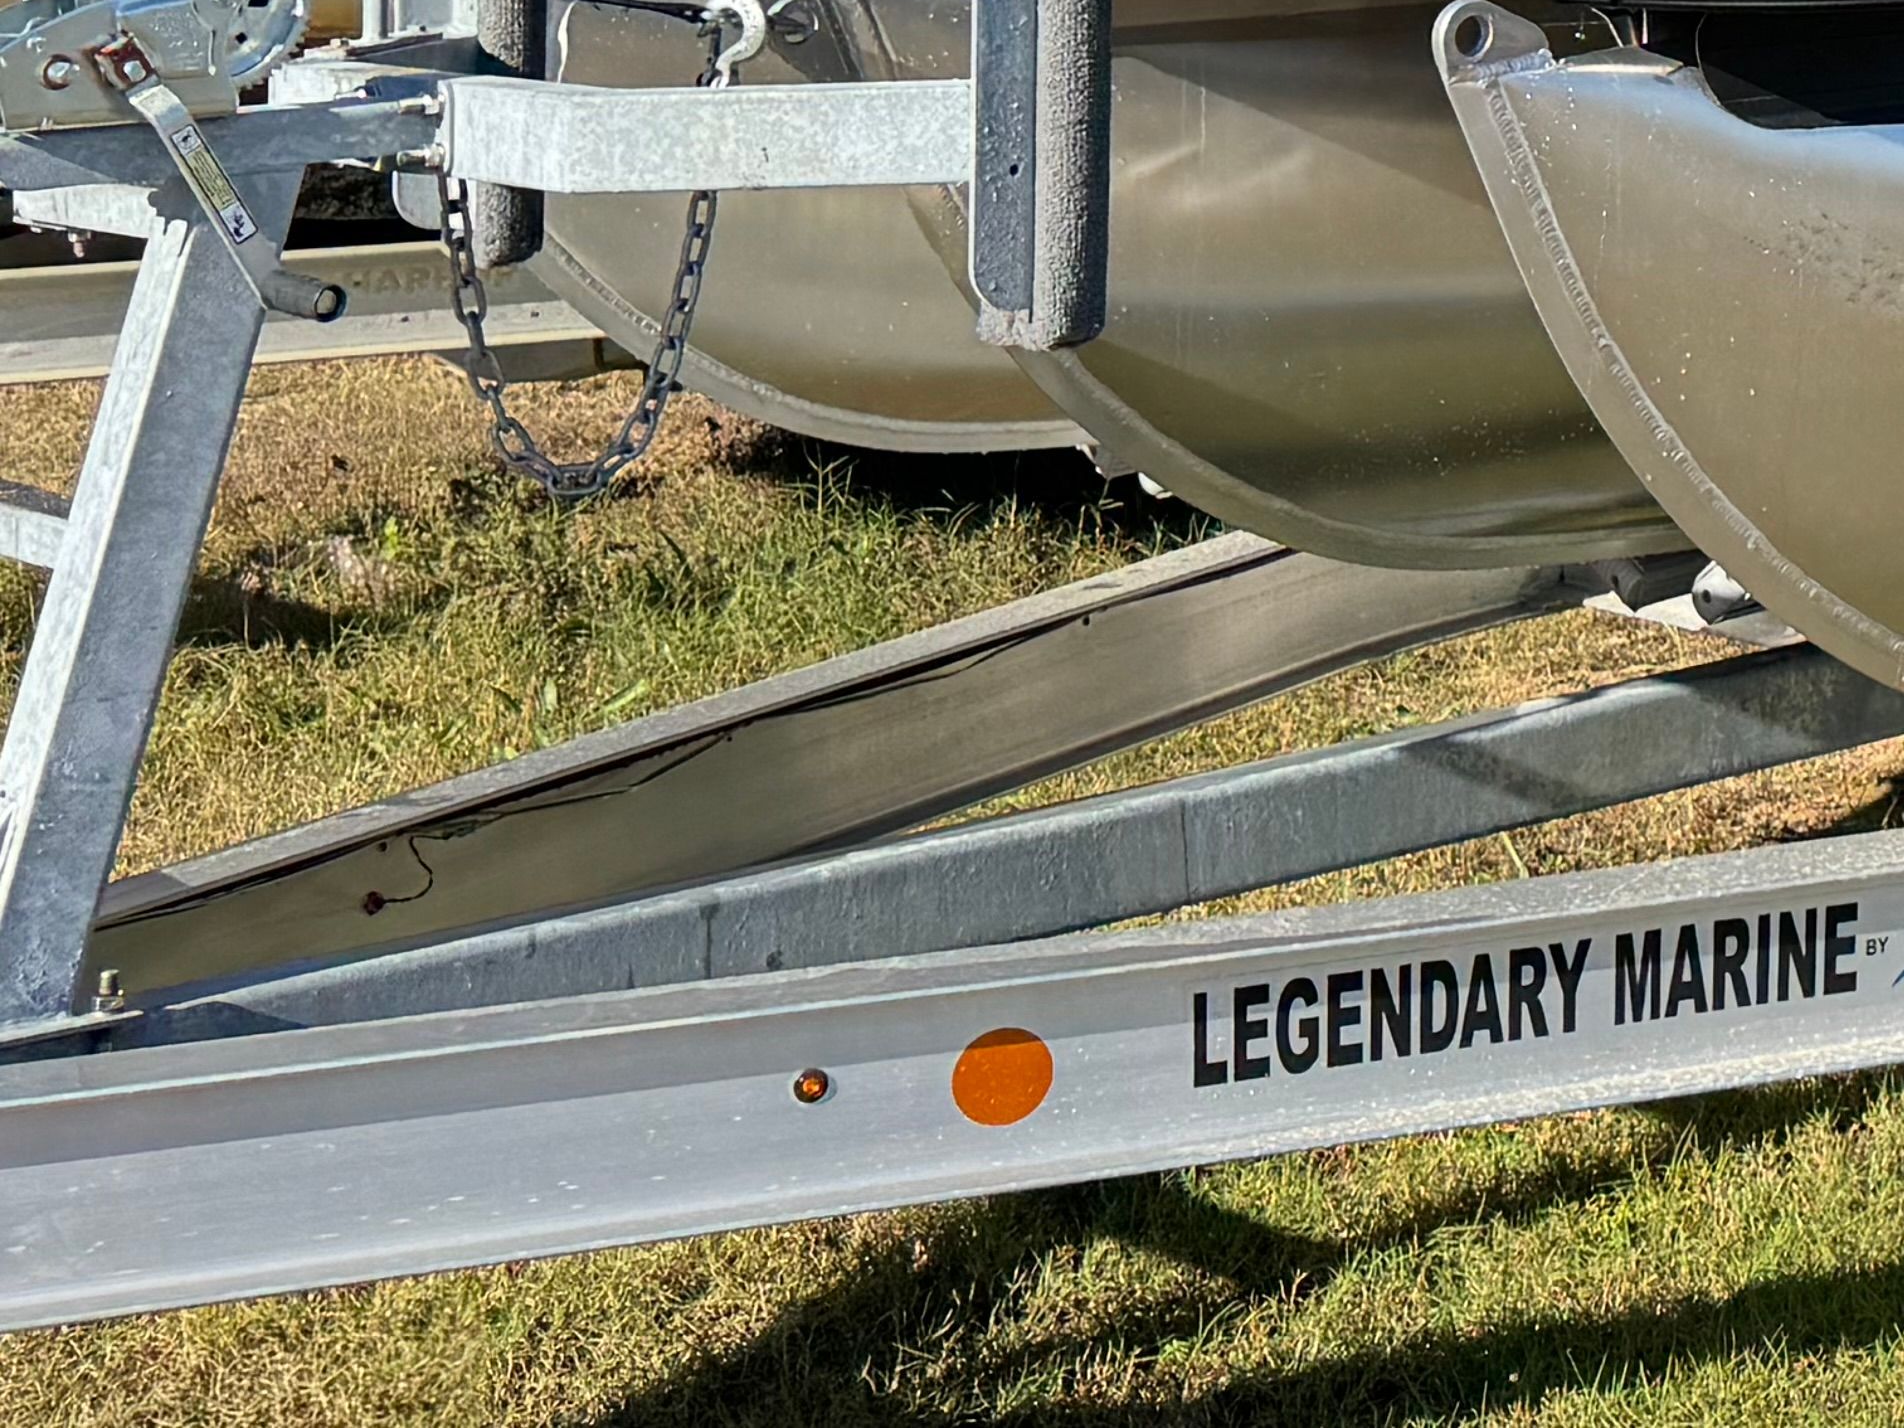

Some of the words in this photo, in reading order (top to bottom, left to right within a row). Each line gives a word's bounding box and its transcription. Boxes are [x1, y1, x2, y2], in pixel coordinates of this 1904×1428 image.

[1193, 937, 1593, 1089] LEGENDARY
[1613, 902, 1859, 1027] MARINE
[1865, 936, 1890, 957] BY
